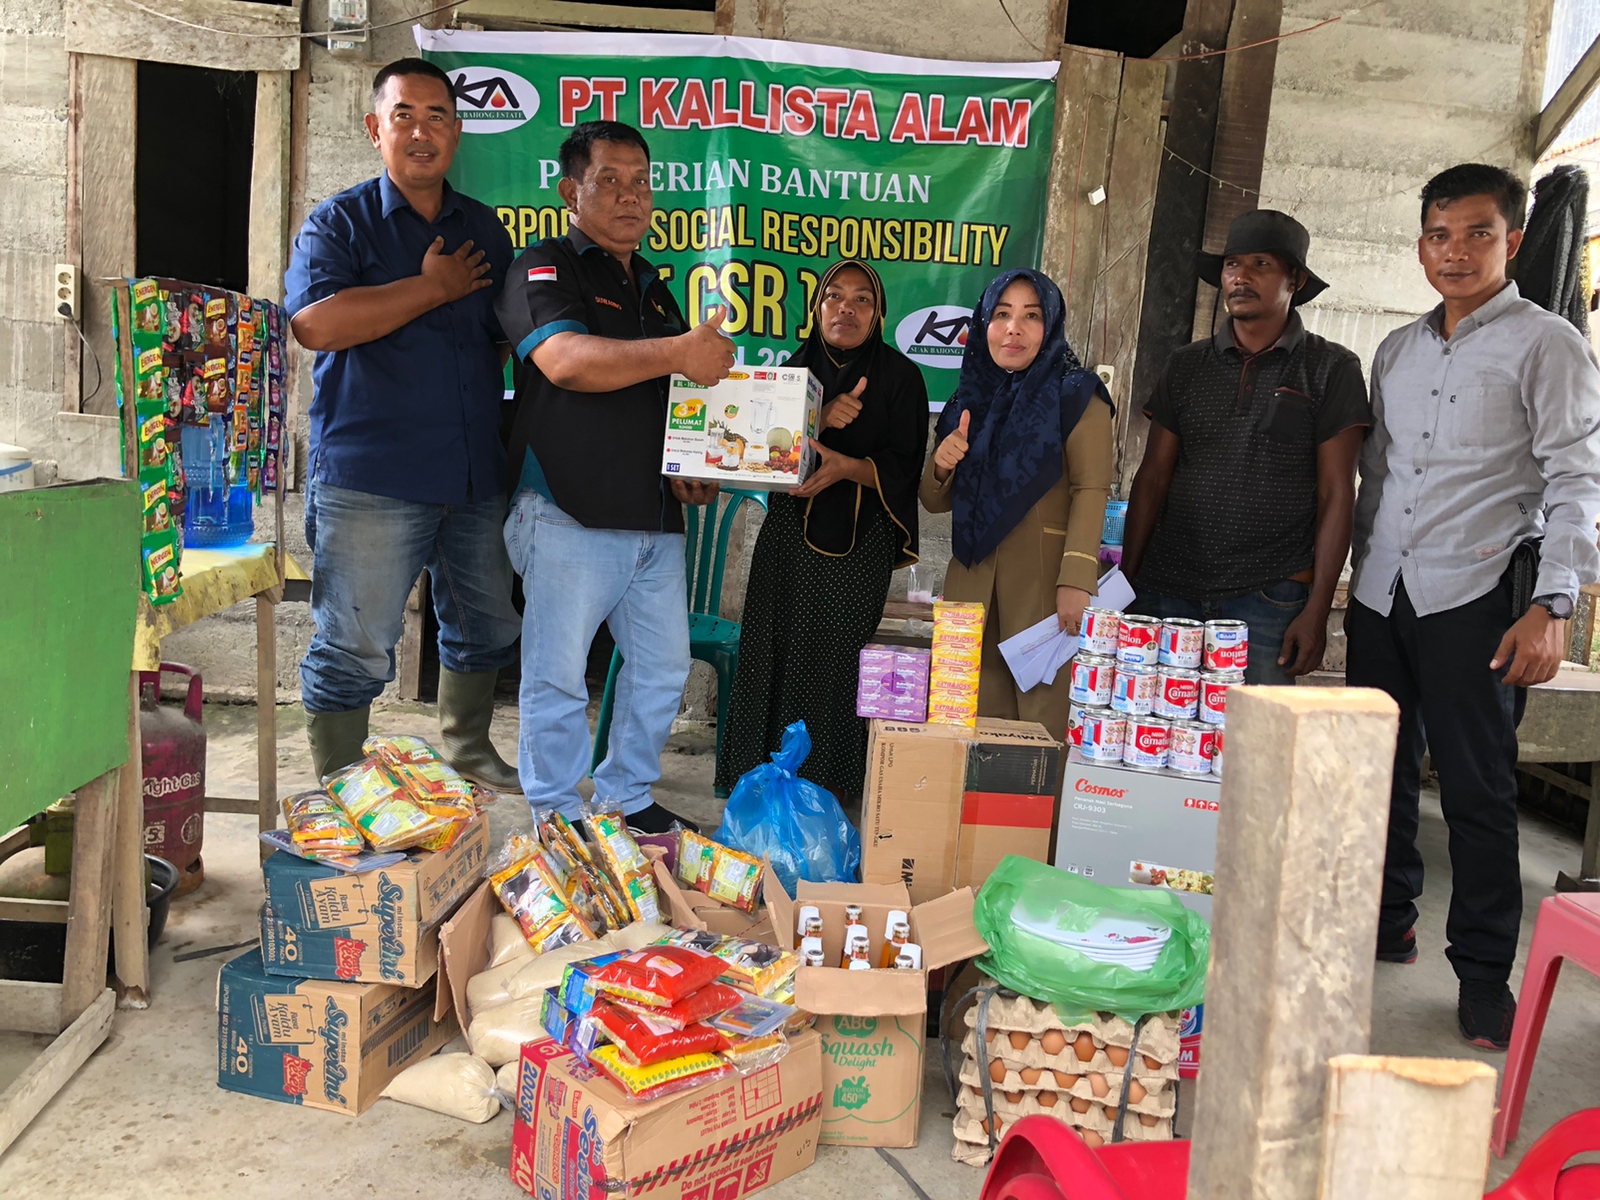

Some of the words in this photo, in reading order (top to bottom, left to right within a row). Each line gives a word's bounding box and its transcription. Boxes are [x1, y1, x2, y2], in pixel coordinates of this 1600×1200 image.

[559, 76, 627, 127] PT
[640, 77, 880, 142] KALLISTA
[890, 92, 1031, 148] ALAM
[539, 159, 751, 192] PERIAN
[760, 163, 931, 203] BANTUAN
[649, 205, 755, 252] SOCIAL
[761, 208, 1010, 266] RESPONSIBILITY
[135, 284, 156, 296] ENERGEN
[687, 260, 787, 339] CSR
[678, 403, 688, 416] 3
[150, 549, 172, 566] NERGEN
[1075, 778, 1125, 798] Cosmos
[1074, 803, 1106, 814] CRJ-9303
[314, 888, 330, 924] Ayam
[324, 886, 342, 922] Kaldu
[340, 894, 349, 912] Rasa
[284, 926, 298, 962] 40
[338, 939, 354, 978] Resep
[268, 1003, 282, 1038] Ayam
[277, 1002, 292, 1038] Kaldu
[290, 1011, 298, 1030] Rasa
[838, 1016, 874, 1030] ABC
[236, 1036, 249, 1074] 40
[822, 1033, 894, 1064] Squash
[838, 1056, 876, 1071] Delight
[285, 1055, 299, 1095] Resep
[552, 1134, 560, 1184] GORENG
[592, 1133, 604, 1166] Mie
[681, 1180, 692, 1192] Do
[694, 1175, 706, 1188] not
[707, 1163, 732, 1180] accept
[733, 1160, 739, 1170] if
[740, 1153, 754, 1167] seal
[755, 1142, 778, 1159] broken
[516, 1152, 532, 1192] 40
